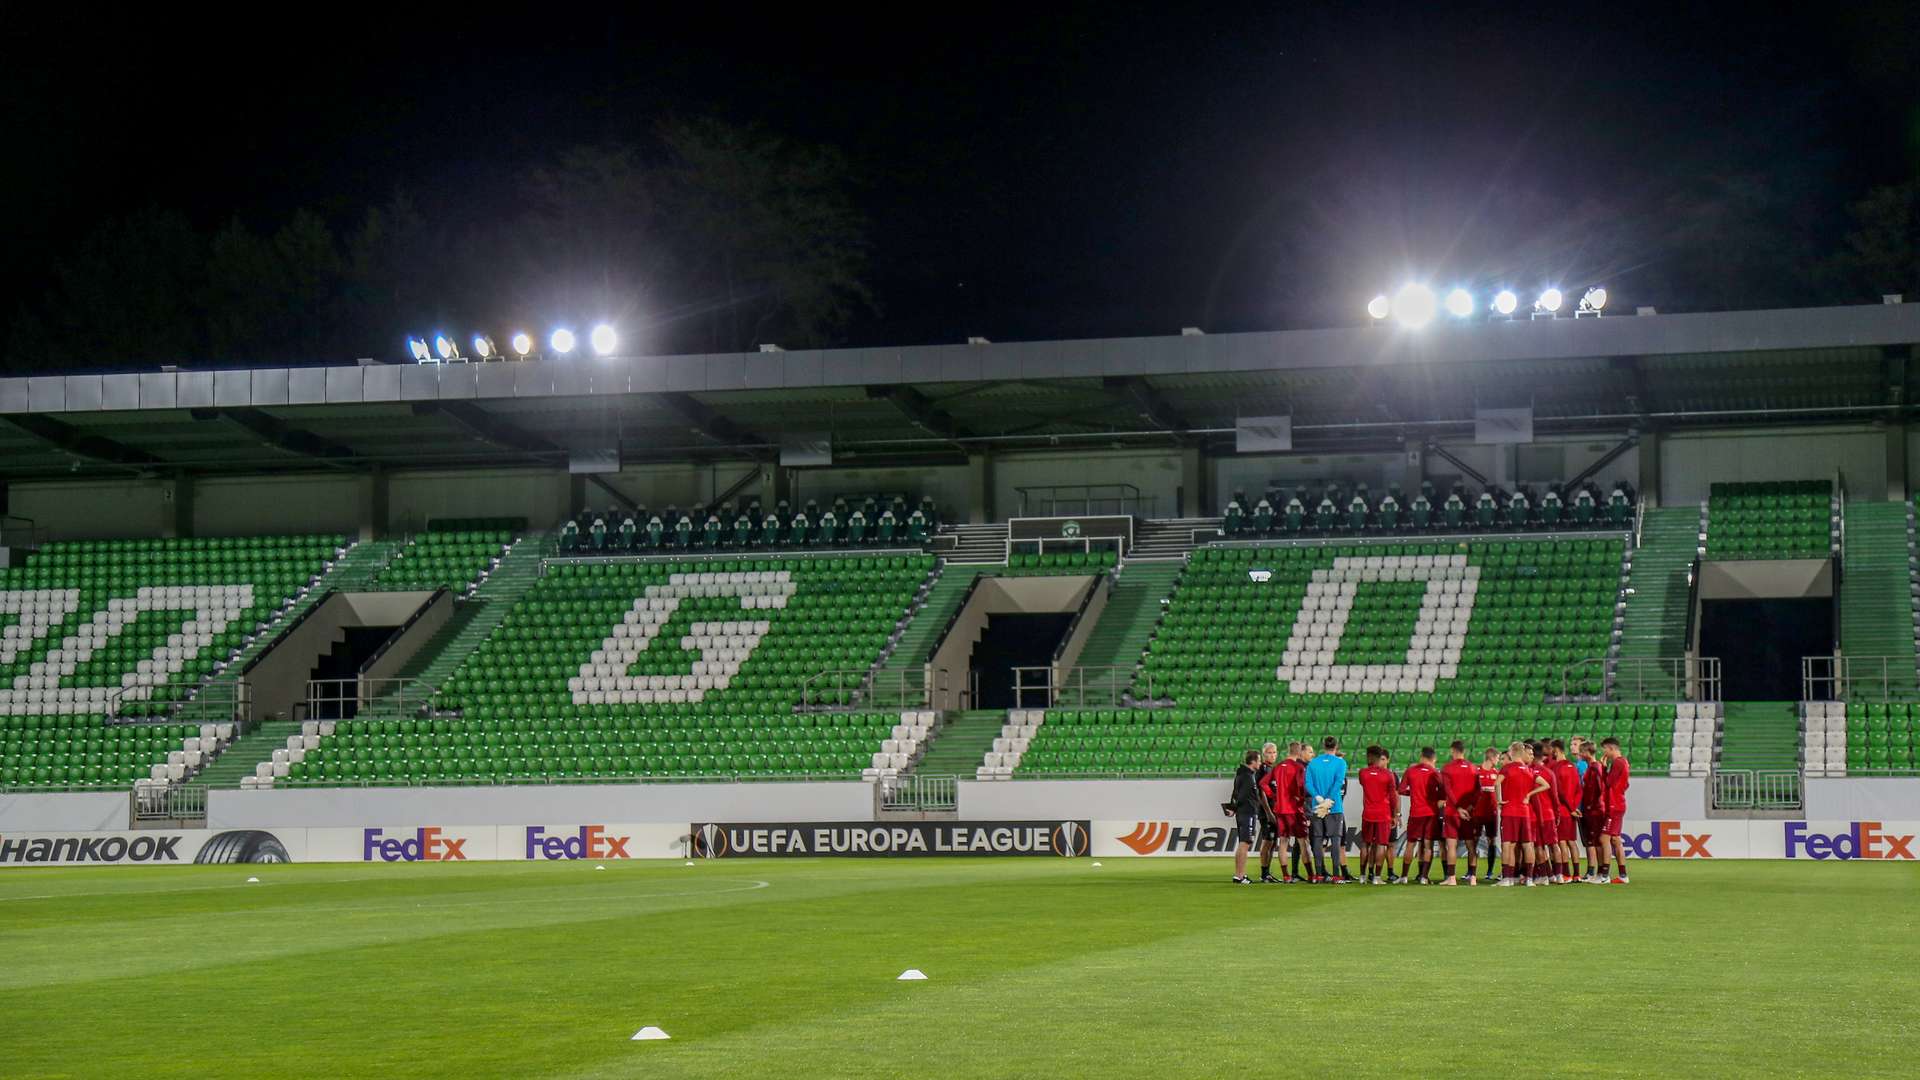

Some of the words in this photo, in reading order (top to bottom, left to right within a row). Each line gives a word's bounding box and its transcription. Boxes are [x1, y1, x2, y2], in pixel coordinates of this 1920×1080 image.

[567, 570, 798, 705] G
[363, 826, 468, 861] FedEx
[526, 825, 631, 860] FedEx
[730, 829, 807, 853] UEFA
[813, 827, 928, 852] EUROPA
[935, 826, 1050, 852] LEAGUE
[1784, 821, 1915, 860] FedEx
